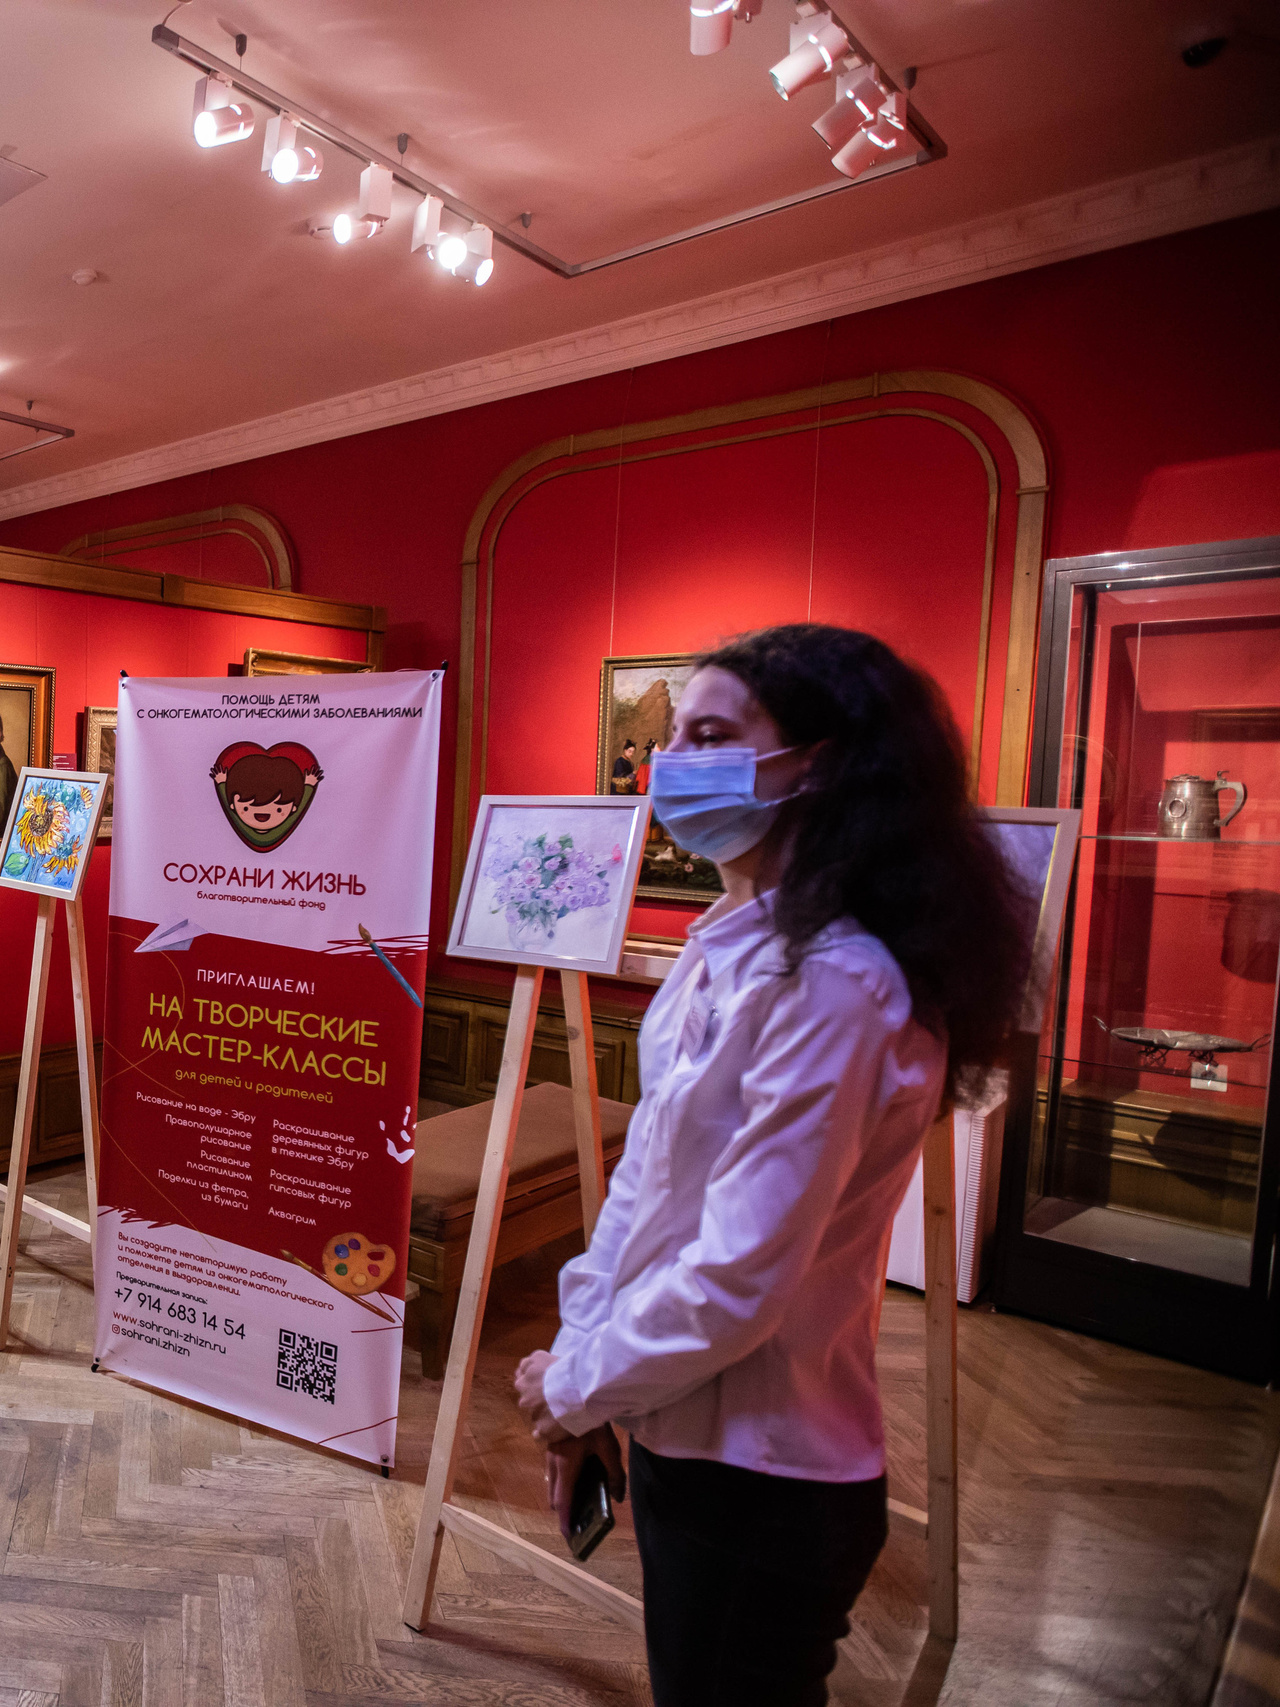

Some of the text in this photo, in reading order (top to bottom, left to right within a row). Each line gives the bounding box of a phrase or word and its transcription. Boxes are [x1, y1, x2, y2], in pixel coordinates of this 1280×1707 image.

[222, 694, 320, 705] ПОМОЩЬ ДЕТЯМ
[137, 708, 422, 718] С ОНКОГЕМАТОЛОГИЧЕСКИМИ ЗАБОЛЕВАНИЯМИ
[164, 862, 366, 895] СОХРАНИ ЖИЗНЬ
[197, 891, 326, 911] благотворительный фонд
[197, 969, 315, 995] ПРИГЛАШАЕМ!
[149, 993, 379, 1047] НА ТВОРЧЕСКИЕ
[141, 1027, 386, 1086] МАСТЕР-КЛАССЫ
[175, 1068, 333, 1104] для детей и родителей
[136, 1092, 183, 1110] Рисование
[186, 1102, 196, 1111] на
[200, 1105, 222, 1117] воде
[231, 1110, 256, 1124] Эбру
[166, 1114, 252, 1139] Правополушарное
[273, 1119, 355, 1143] Раскрашивание
[201, 1135, 251, 1151] рисование
[272, 1132, 369, 1160] деревянных фигур
[187, 1161, 252, 1181] пластилином
[201, 1150, 250, 1168] Рисование
[272, 1146, 354, 1170] в технике Эбру
[158, 1169, 249, 1199] Поделки из фетра,
[270, 1169, 351, 1195] Раскрашивание
[202, 1193, 248, 1211] из бумаги
[269, 1183, 351, 1209] гипсовых фигур
[269, 1206, 316, 1226] Аквагрим
[118, 1232, 287, 1287] Вы создадите неповторимую работу
[116, 1271, 179, 1296] Предварительная
[117, 1255, 241, 1296] отделения в выздоровлении.
[126, 1247, 171, 1266] поможете
[174, 1260, 204, 1274] детям
[205, 1266, 216, 1277] из
[218, 1270, 334, 1311] онкогематологического
[115, 1287, 245, 1340] +7 914 683 14 54
[113, 1310, 226, 1354] www.sohrani-zhizn.ru
